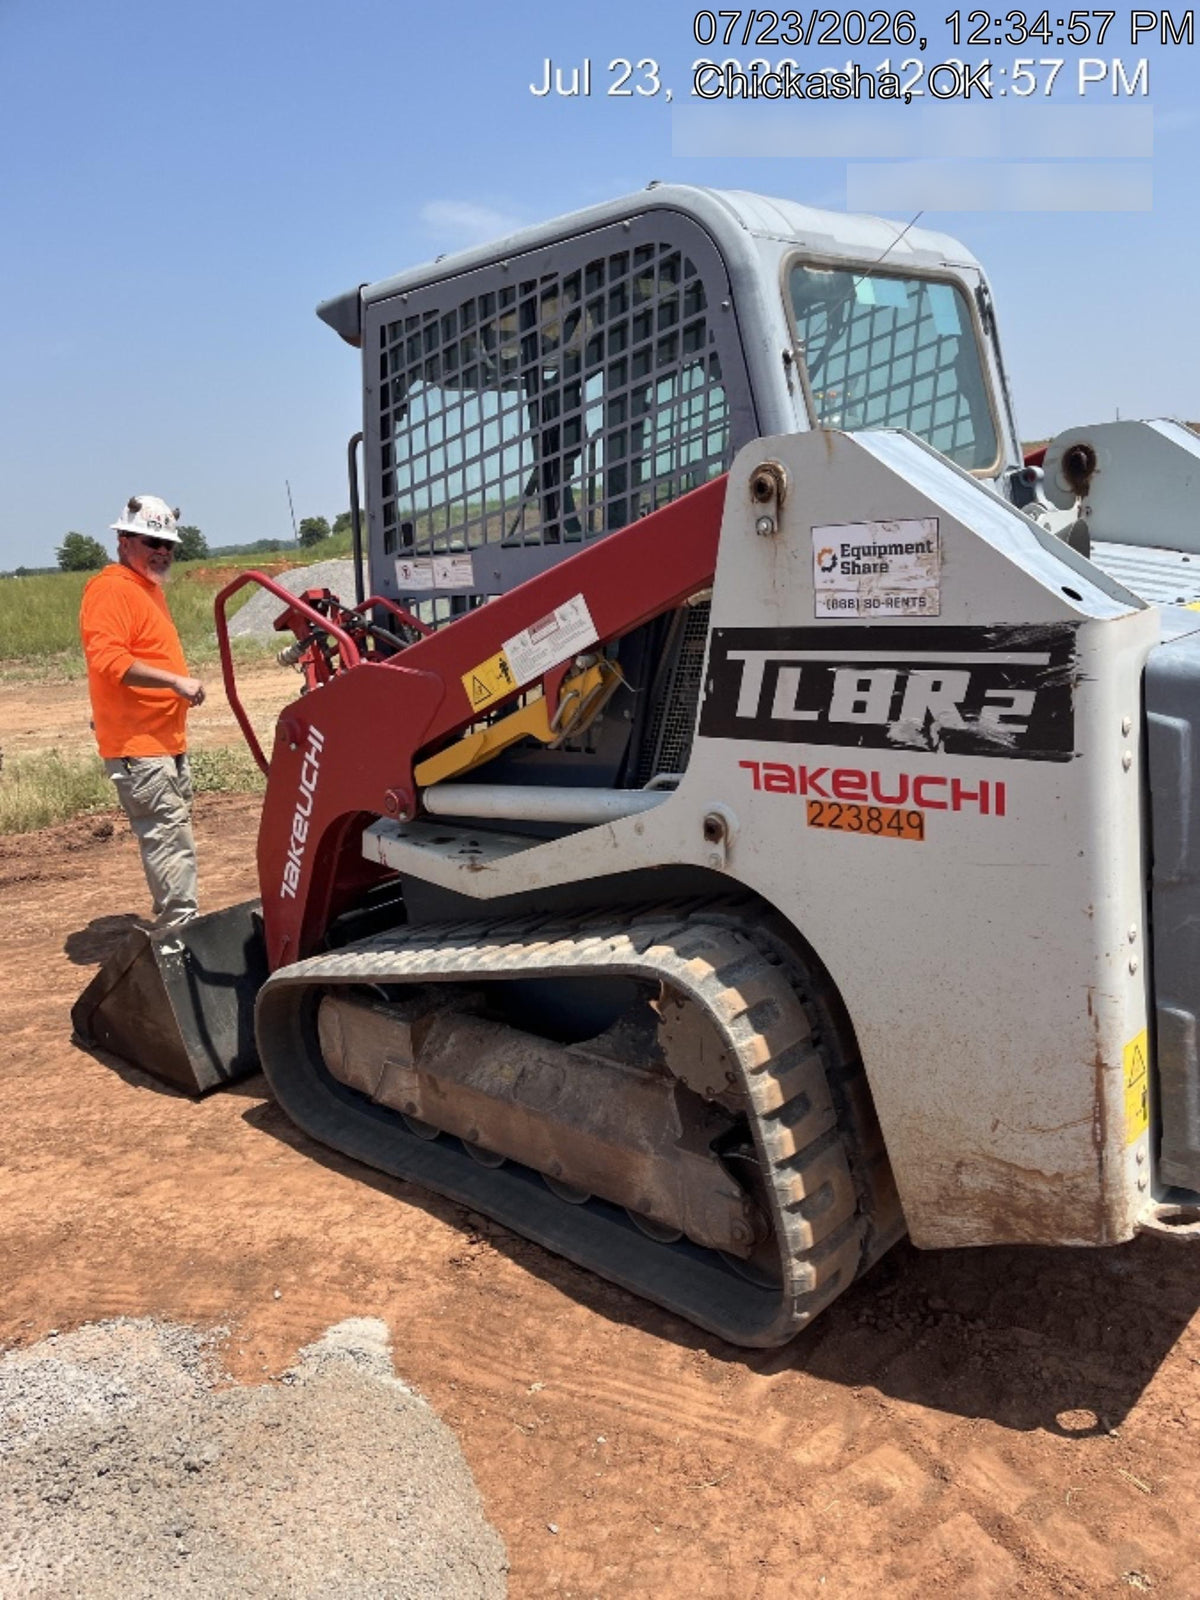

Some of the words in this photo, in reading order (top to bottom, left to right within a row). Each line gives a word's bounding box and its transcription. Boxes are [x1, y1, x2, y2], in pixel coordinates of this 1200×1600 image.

[840, 540, 934, 560] Equipment
[840, 561, 889, 575] Share
[808, 801, 925, 839] 223849
